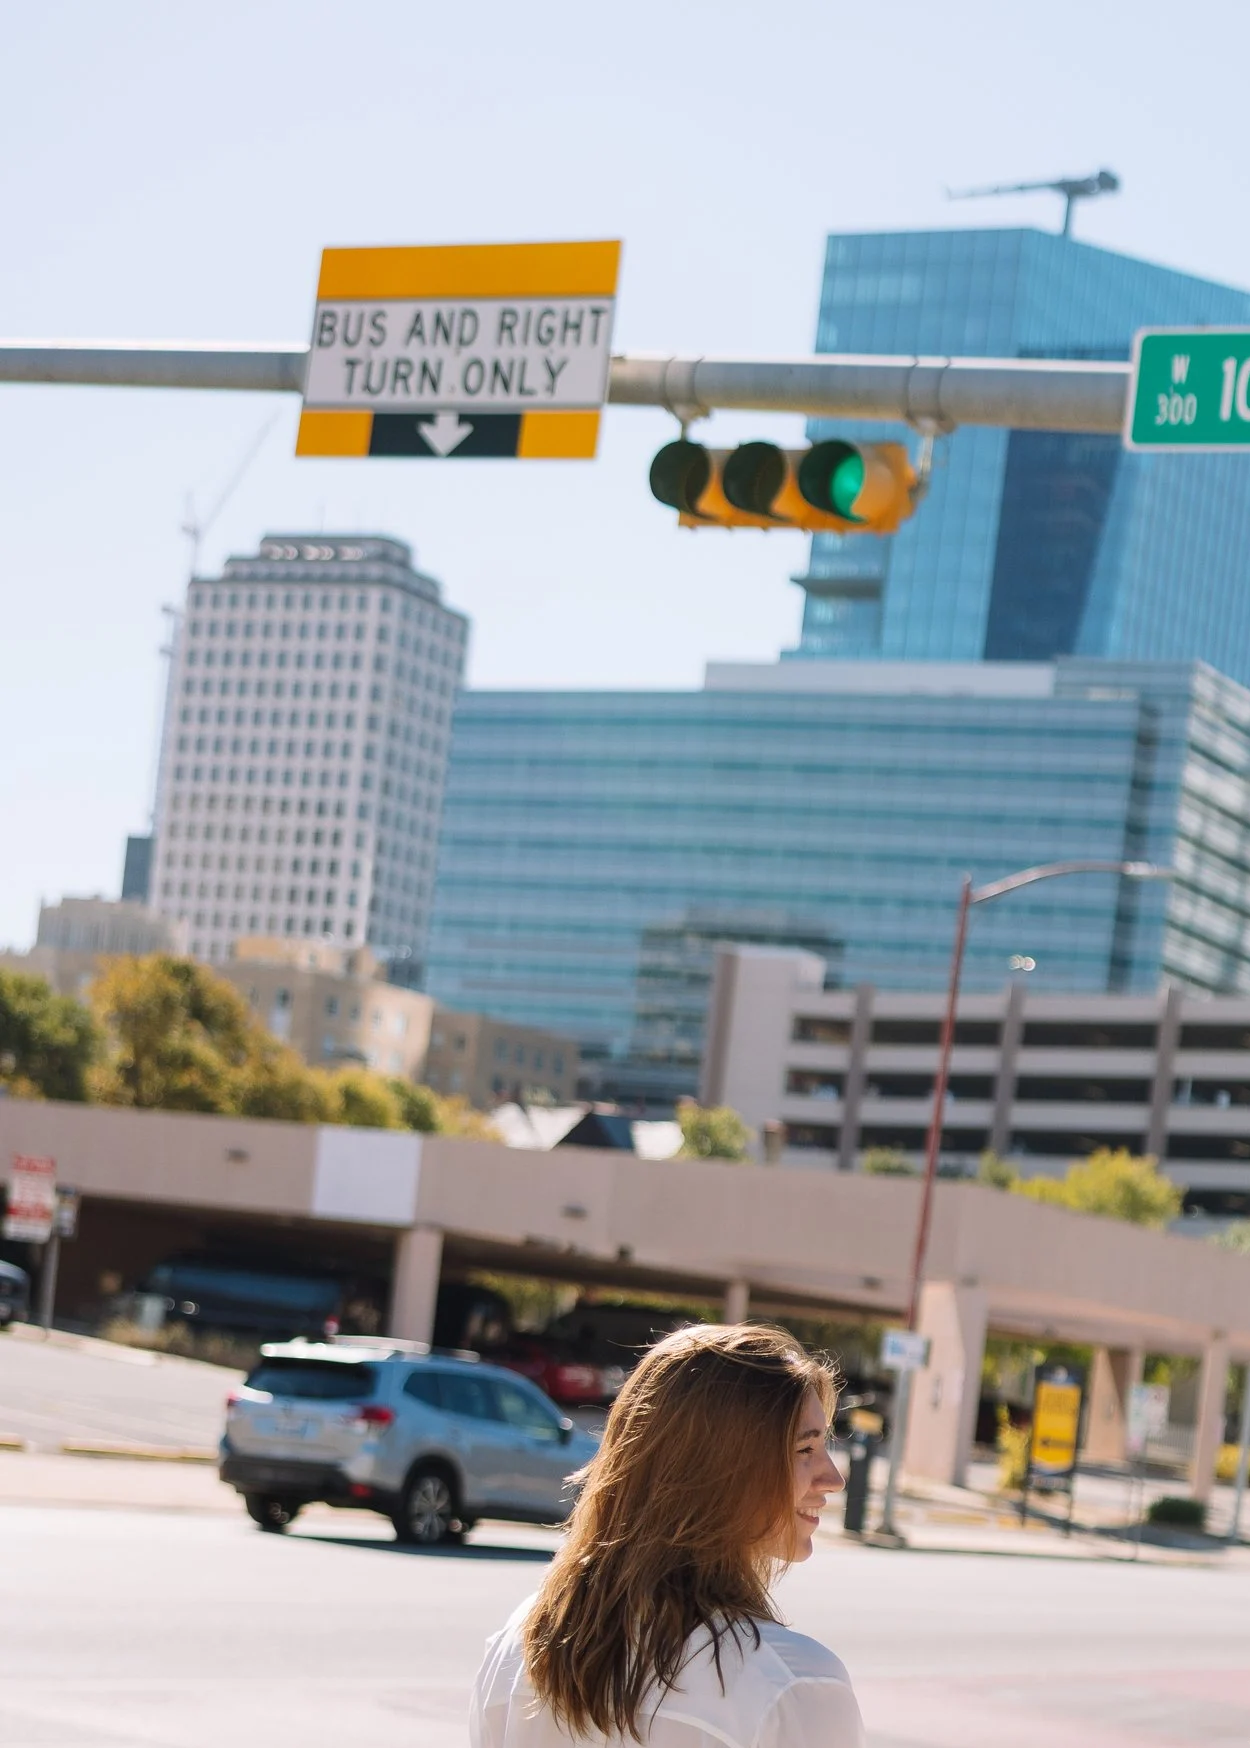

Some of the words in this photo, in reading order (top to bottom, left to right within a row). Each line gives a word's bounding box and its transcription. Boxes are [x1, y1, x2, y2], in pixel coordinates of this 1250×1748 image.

[316, 308, 389, 348] BUS
[404, 308, 480, 347] AND
[498, 306, 609, 346] RIGHT
[344, 357, 443, 396] TURN
[461, 357, 568, 396] ONLY
[1171, 354, 1190, 384] W
[1154, 393, 1198, 426] 300
